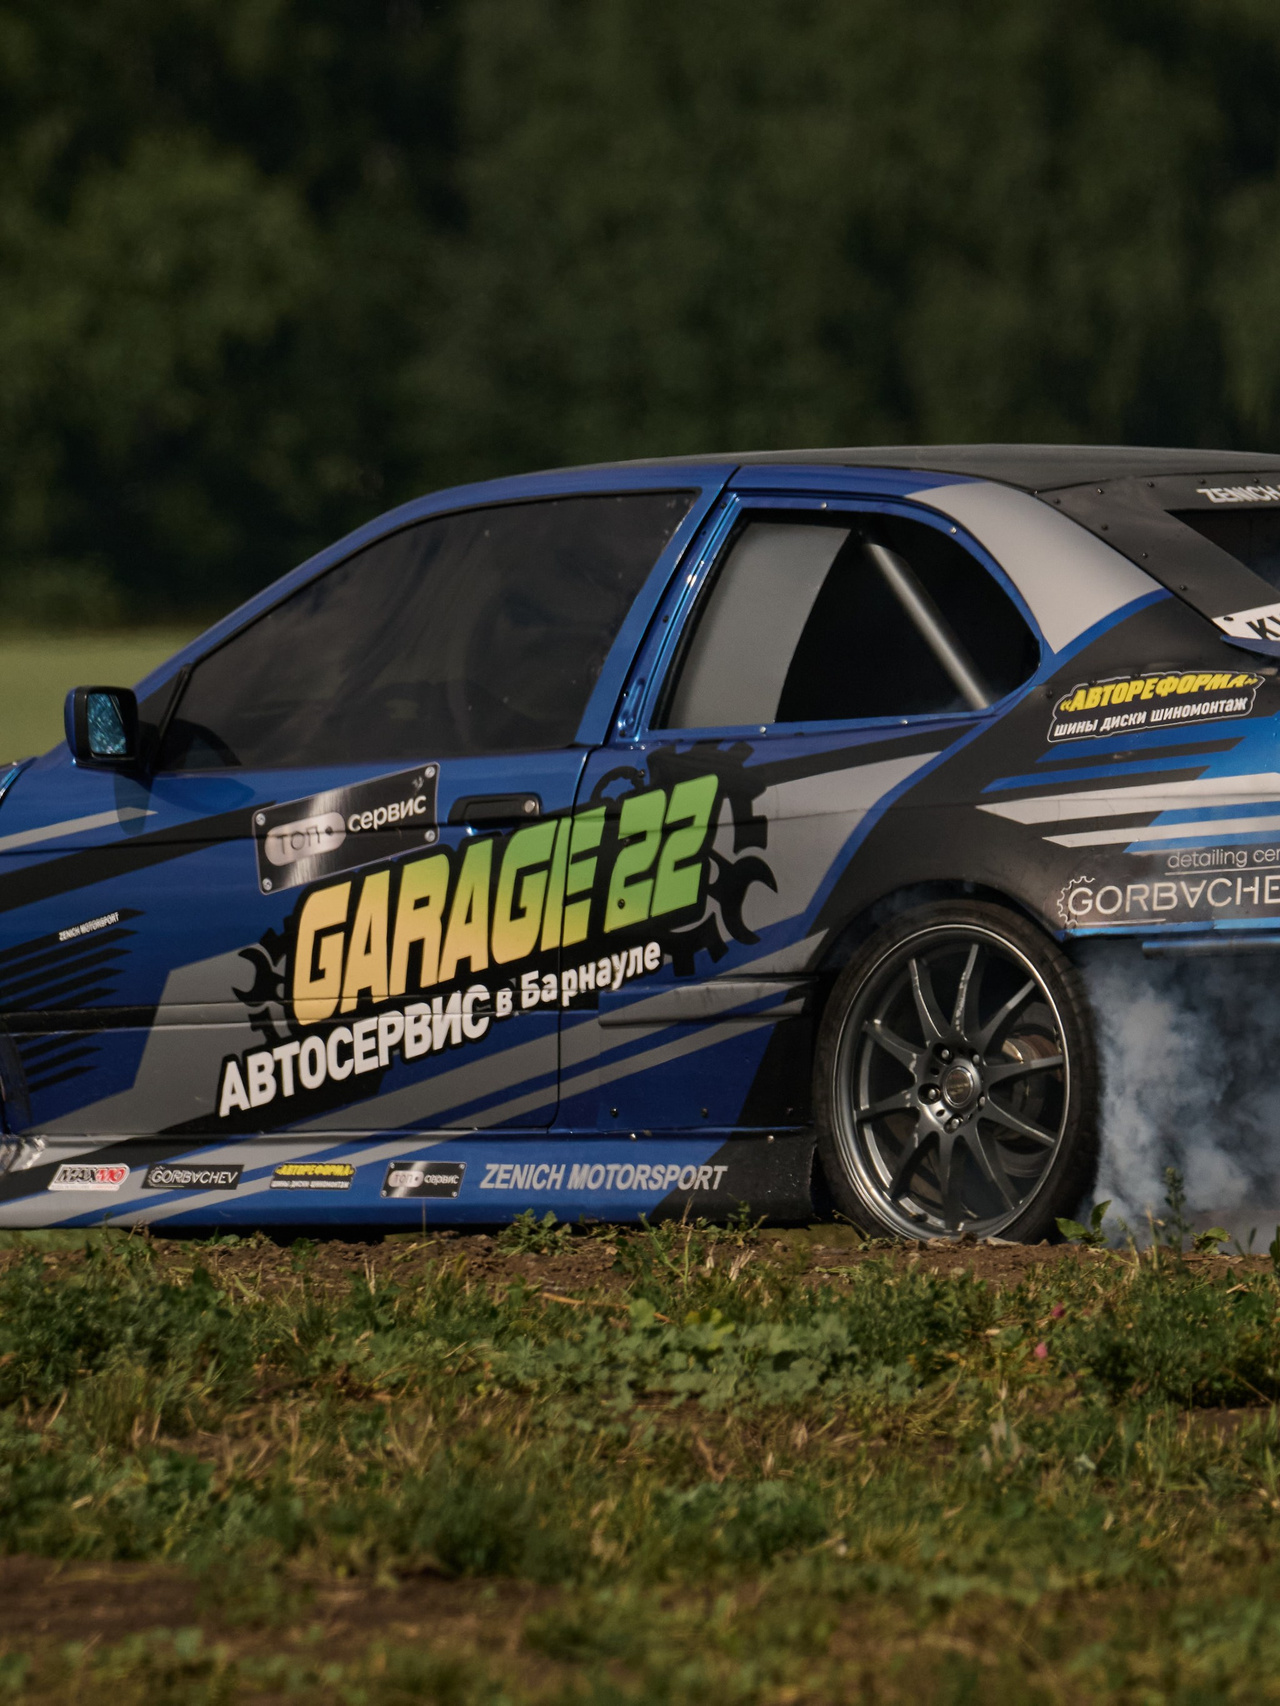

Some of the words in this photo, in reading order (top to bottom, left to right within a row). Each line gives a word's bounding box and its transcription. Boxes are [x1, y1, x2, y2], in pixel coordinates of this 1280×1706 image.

[1060, 674, 1259, 712] «АВТОРЕФОРМА»
[276, 825, 321, 854] ТОП
[347, 795, 427, 832] сервис
[1167, 848, 1248, 869] detailing
[293, 806, 607, 1026] GARAGE
[603, 774, 719, 934] 22
[219, 984, 491, 1118] АВТОСЕРВИС
[495, 987, 513, 1017] в
[520, 941, 662, 1006] Барнауле
[480, 1163, 565, 1190] ZENICH
[566, 1163, 729, 1191] MOTORSPORT
